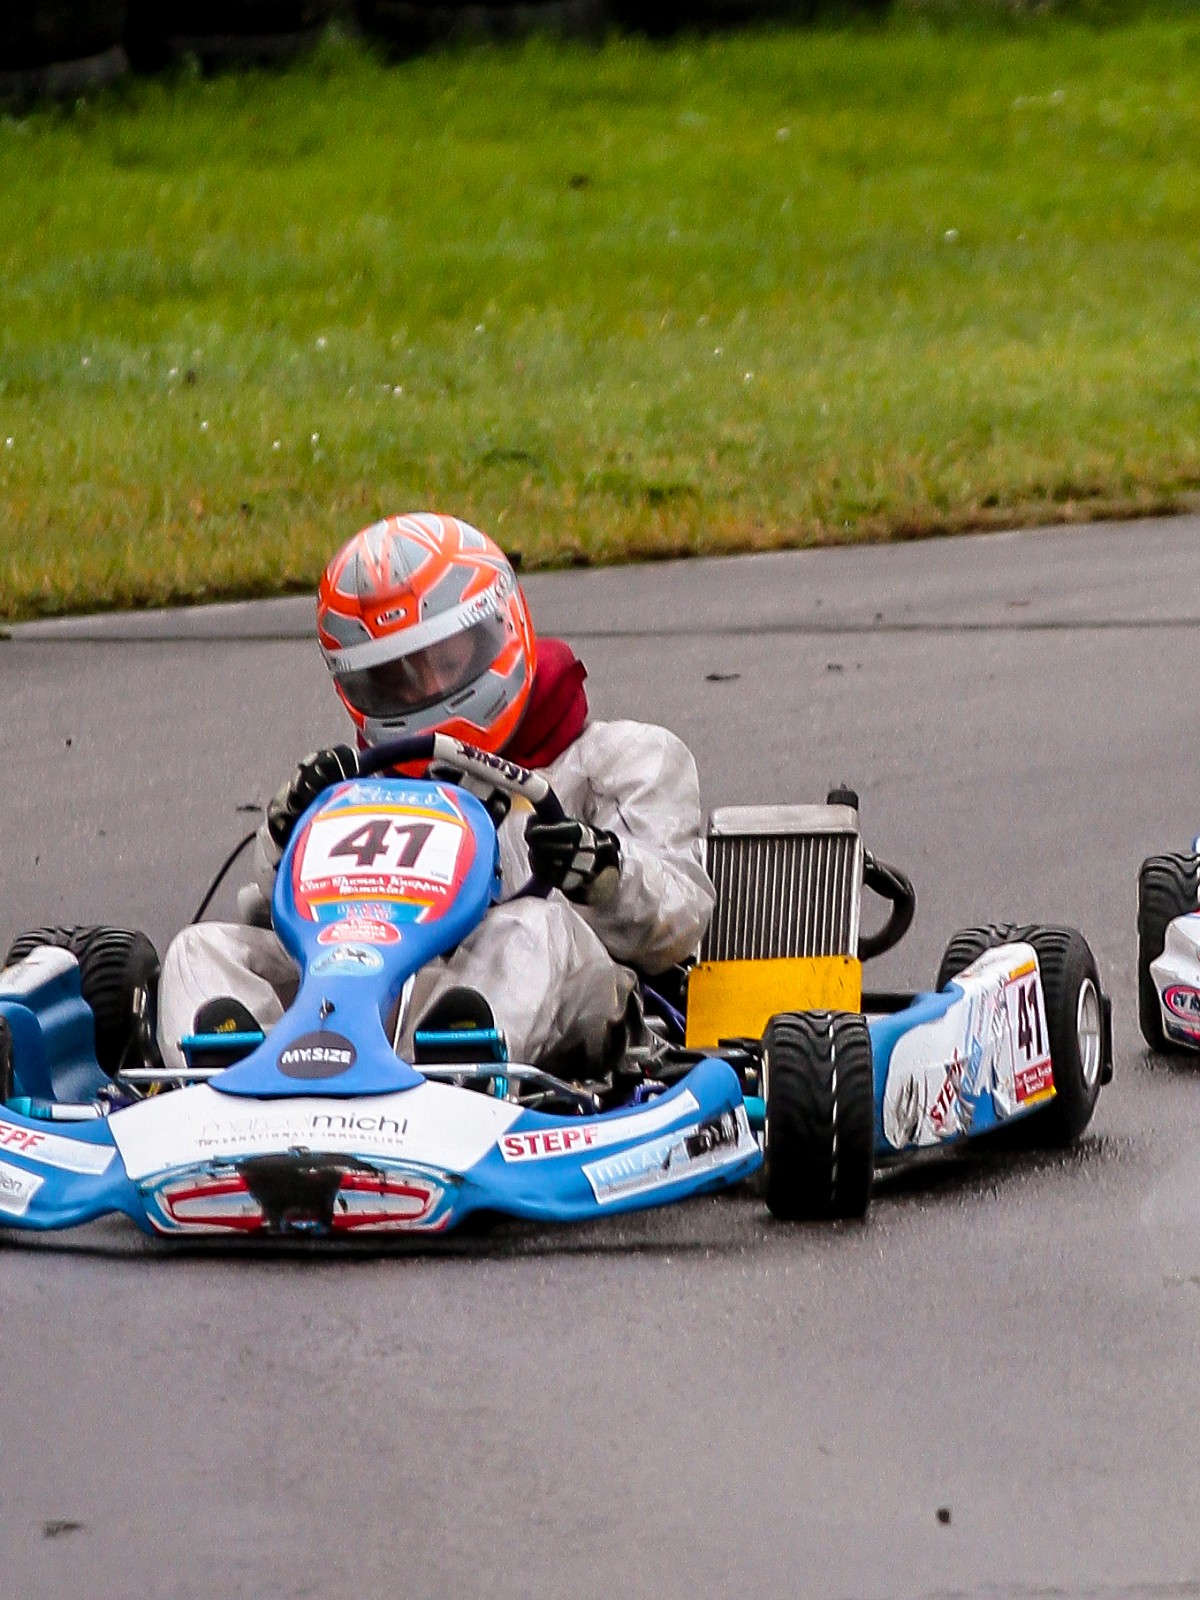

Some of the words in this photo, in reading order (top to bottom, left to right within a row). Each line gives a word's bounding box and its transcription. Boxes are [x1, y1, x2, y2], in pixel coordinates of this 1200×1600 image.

[327, 818, 436, 869] 41
[1018, 979, 1043, 1060] 41
[281, 1046, 352, 1065] MYSIZE
[312, 1111, 409, 1136] michl
[503, 1125, 600, 1157] STEPF
